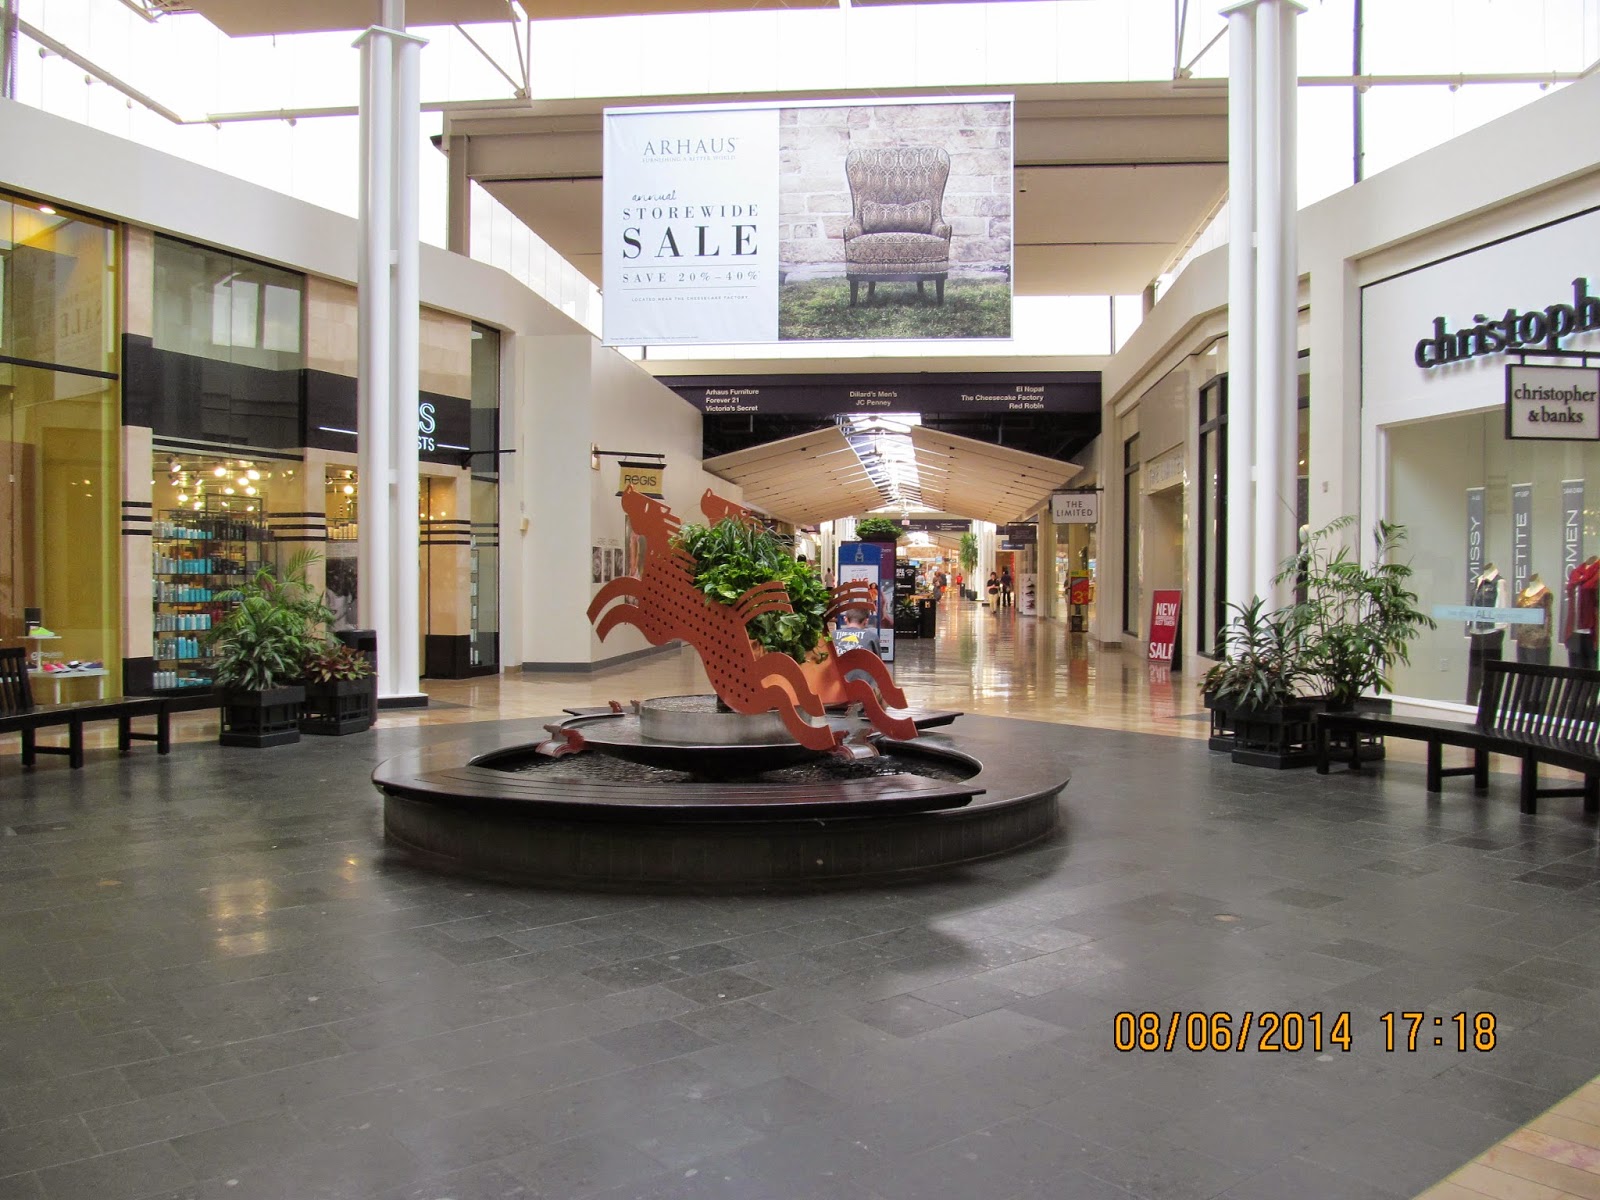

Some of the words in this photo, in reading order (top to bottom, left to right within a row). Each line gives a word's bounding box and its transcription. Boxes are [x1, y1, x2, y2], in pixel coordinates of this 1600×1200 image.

[643, 137, 736, 155] ARHAUS
[632, 190, 677, 201] annual
[623, 204, 758, 220] STOREWIDE
[622, 224, 758, 259] SALE
[622, 272, 667, 284] SAVE
[1017, 394, 1044, 402] Factory
[1513, 383, 1597, 404] christopher
[1541, 406, 1584, 423] banks
[1056, 509, 1093, 517] LIMITED
[1470, 517, 1481, 584] MISSY
[1515, 512, 1527, 594] PETITE
[1564, 509, 1578, 601] OMEN
[1155, 602, 1177, 616] NEW
[1149, 641, 1174, 660] SALE
